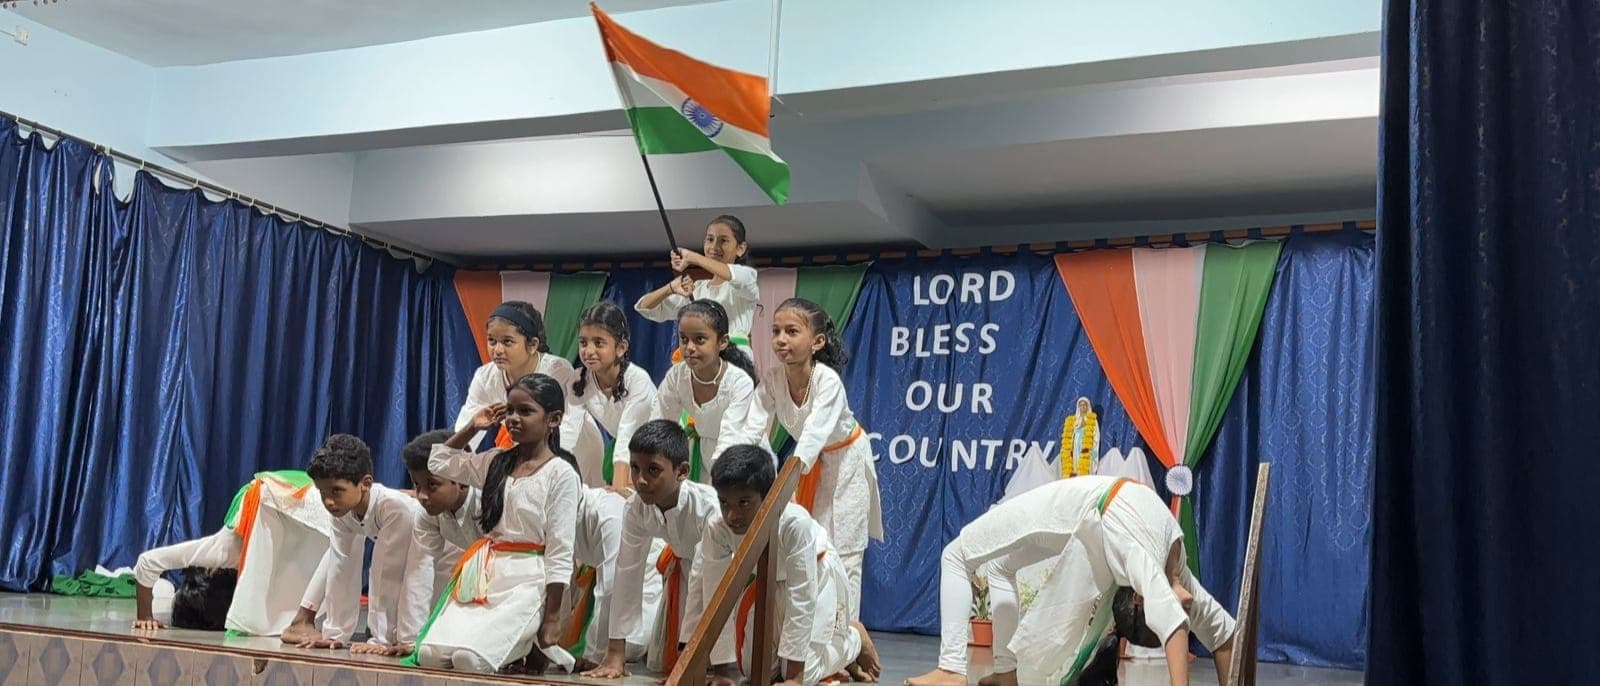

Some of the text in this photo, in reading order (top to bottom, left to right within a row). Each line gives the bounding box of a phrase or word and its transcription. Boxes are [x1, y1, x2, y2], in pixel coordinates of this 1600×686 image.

[913, 270, 1015, 305] LORD
[890, 322, 1000, 357] BLESS
[905, 380, 993, 413] OUR
